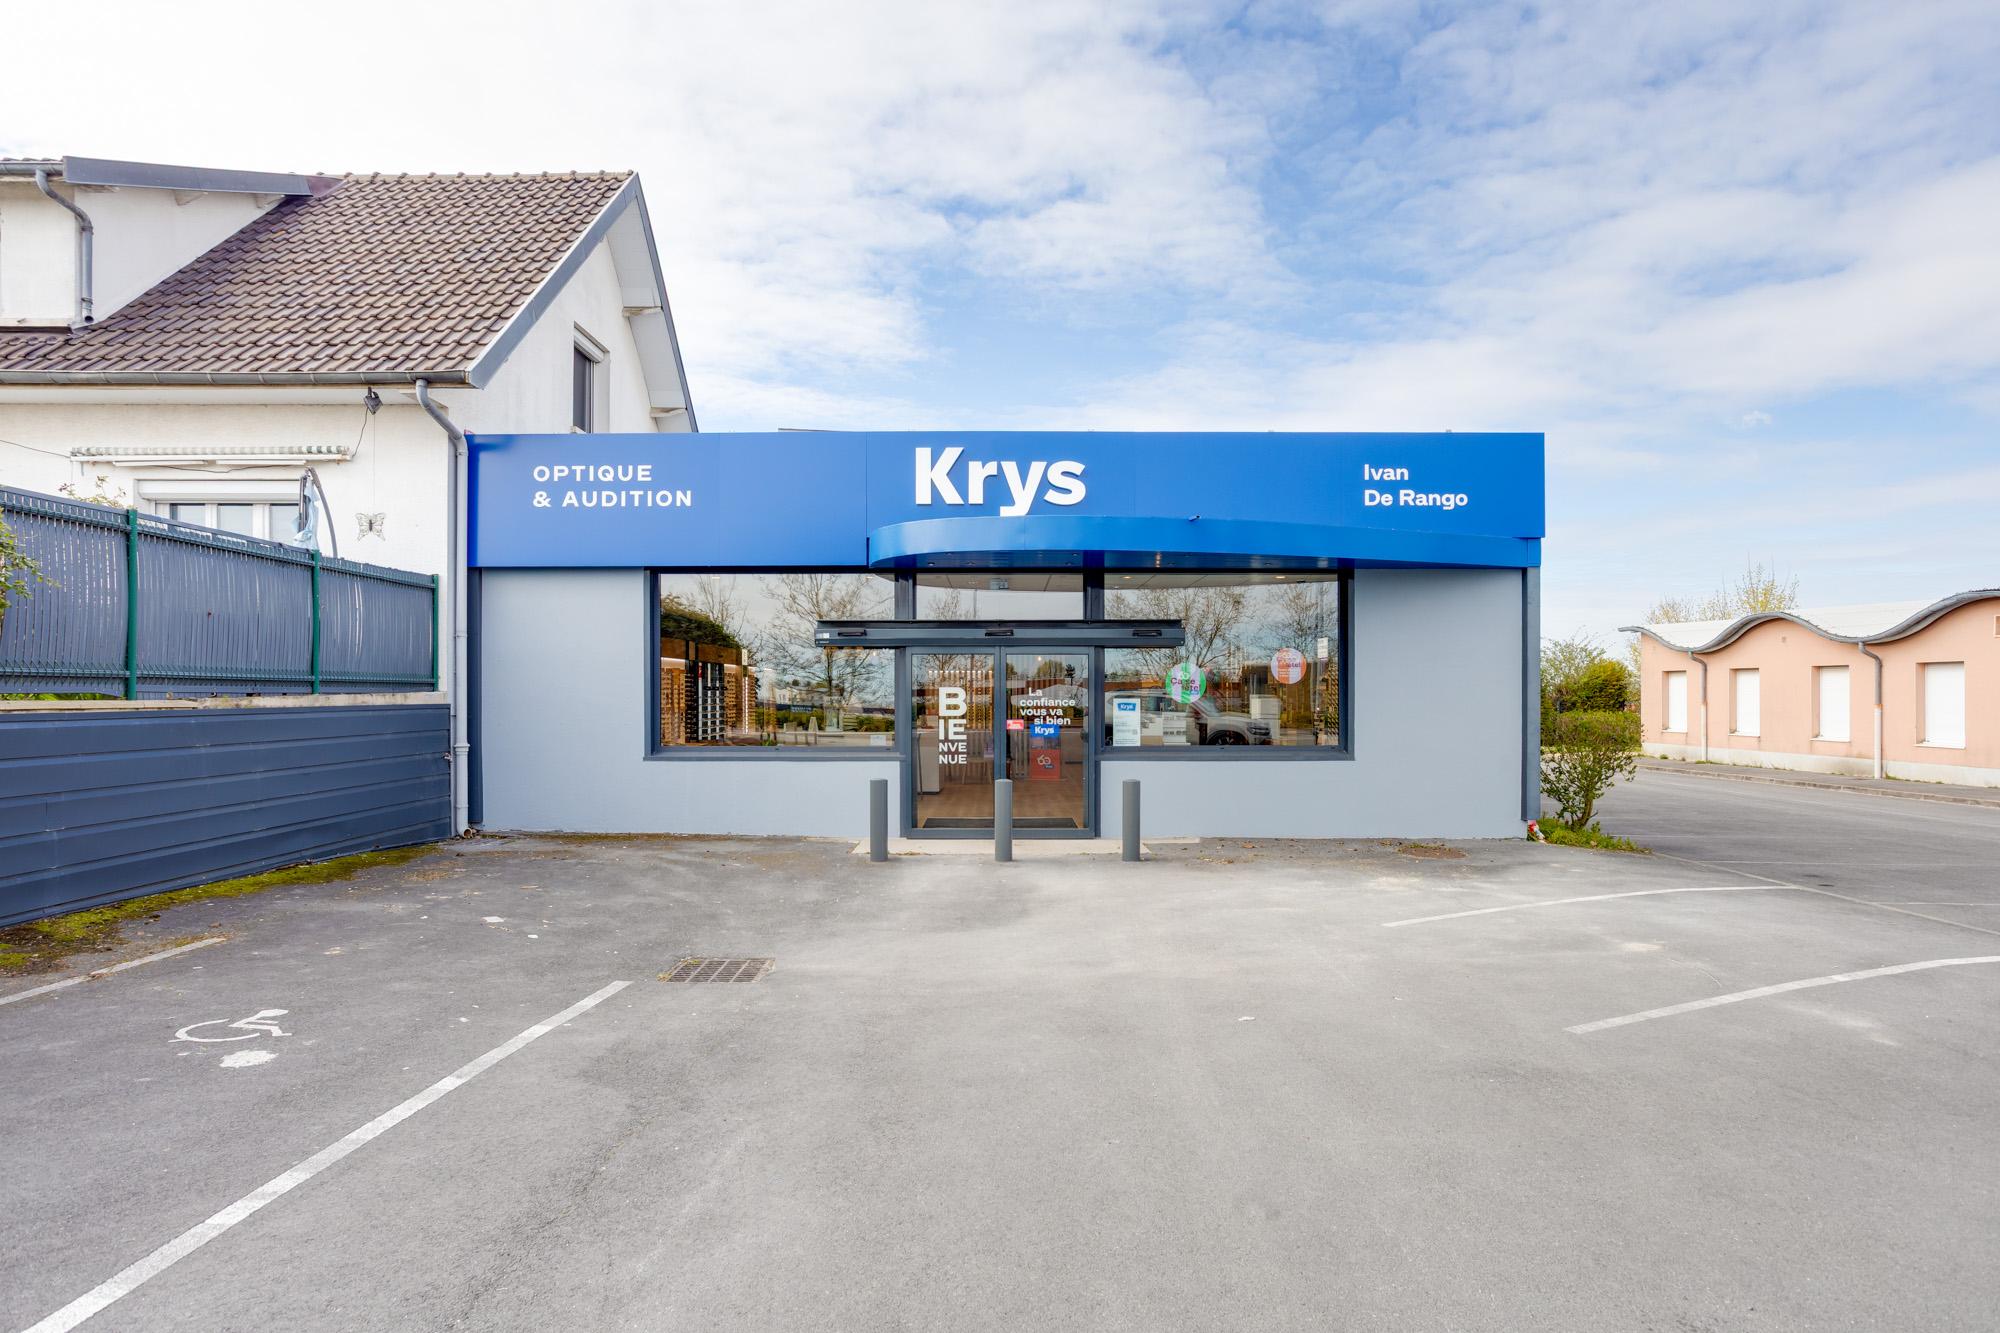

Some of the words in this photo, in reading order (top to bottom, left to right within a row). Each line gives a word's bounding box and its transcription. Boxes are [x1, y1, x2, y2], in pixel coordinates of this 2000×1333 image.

[532, 464, 652, 482] OPTIQUE
[1364, 464, 1409, 481] Ivan
[915, 447, 1086, 516] Krys
[532, 490, 552, 508] &
[561, 490, 692, 508] AUDITION
[1364, 489, 1393, 506] De
[1399, 489, 1468, 510] Rango
[1028, 687, 1042, 696] La
[938, 687, 967, 717] B
[1020, 697, 1075, 706] confiance
[1020, 708, 1047, 716] vous
[1049, 708, 1063, 716] va
[1034, 716, 1044, 725] si
[1046, 716, 1071, 725] bien
[938, 719, 967, 740] IE
[1034, 726, 1054, 735] Krys
[938, 742, 967, 752] NVE
[938, 754, 967, 764] NUE
